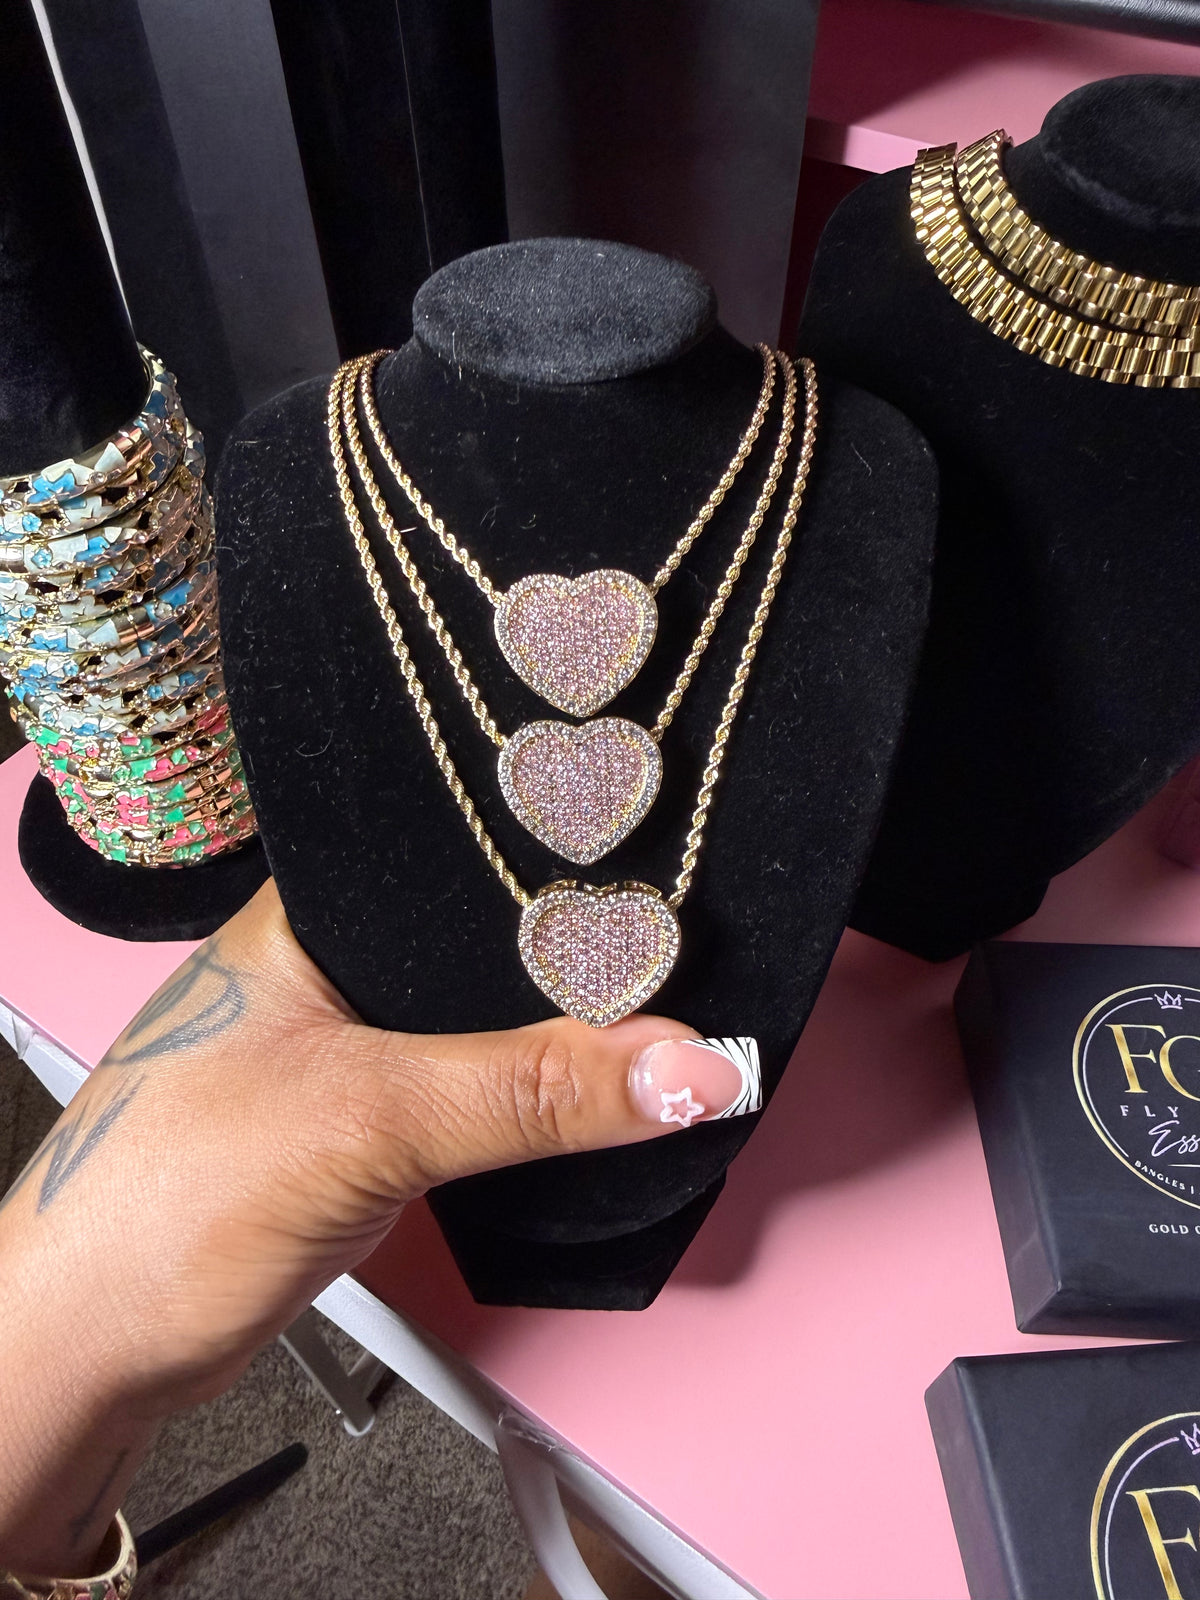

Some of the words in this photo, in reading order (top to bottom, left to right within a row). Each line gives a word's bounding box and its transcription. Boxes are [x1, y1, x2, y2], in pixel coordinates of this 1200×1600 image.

[1120, 1105, 1178, 1117] FLY
[1135, 1160, 1185, 1190] BANGLES
[1149, 1224, 1189, 1235] GOLD
